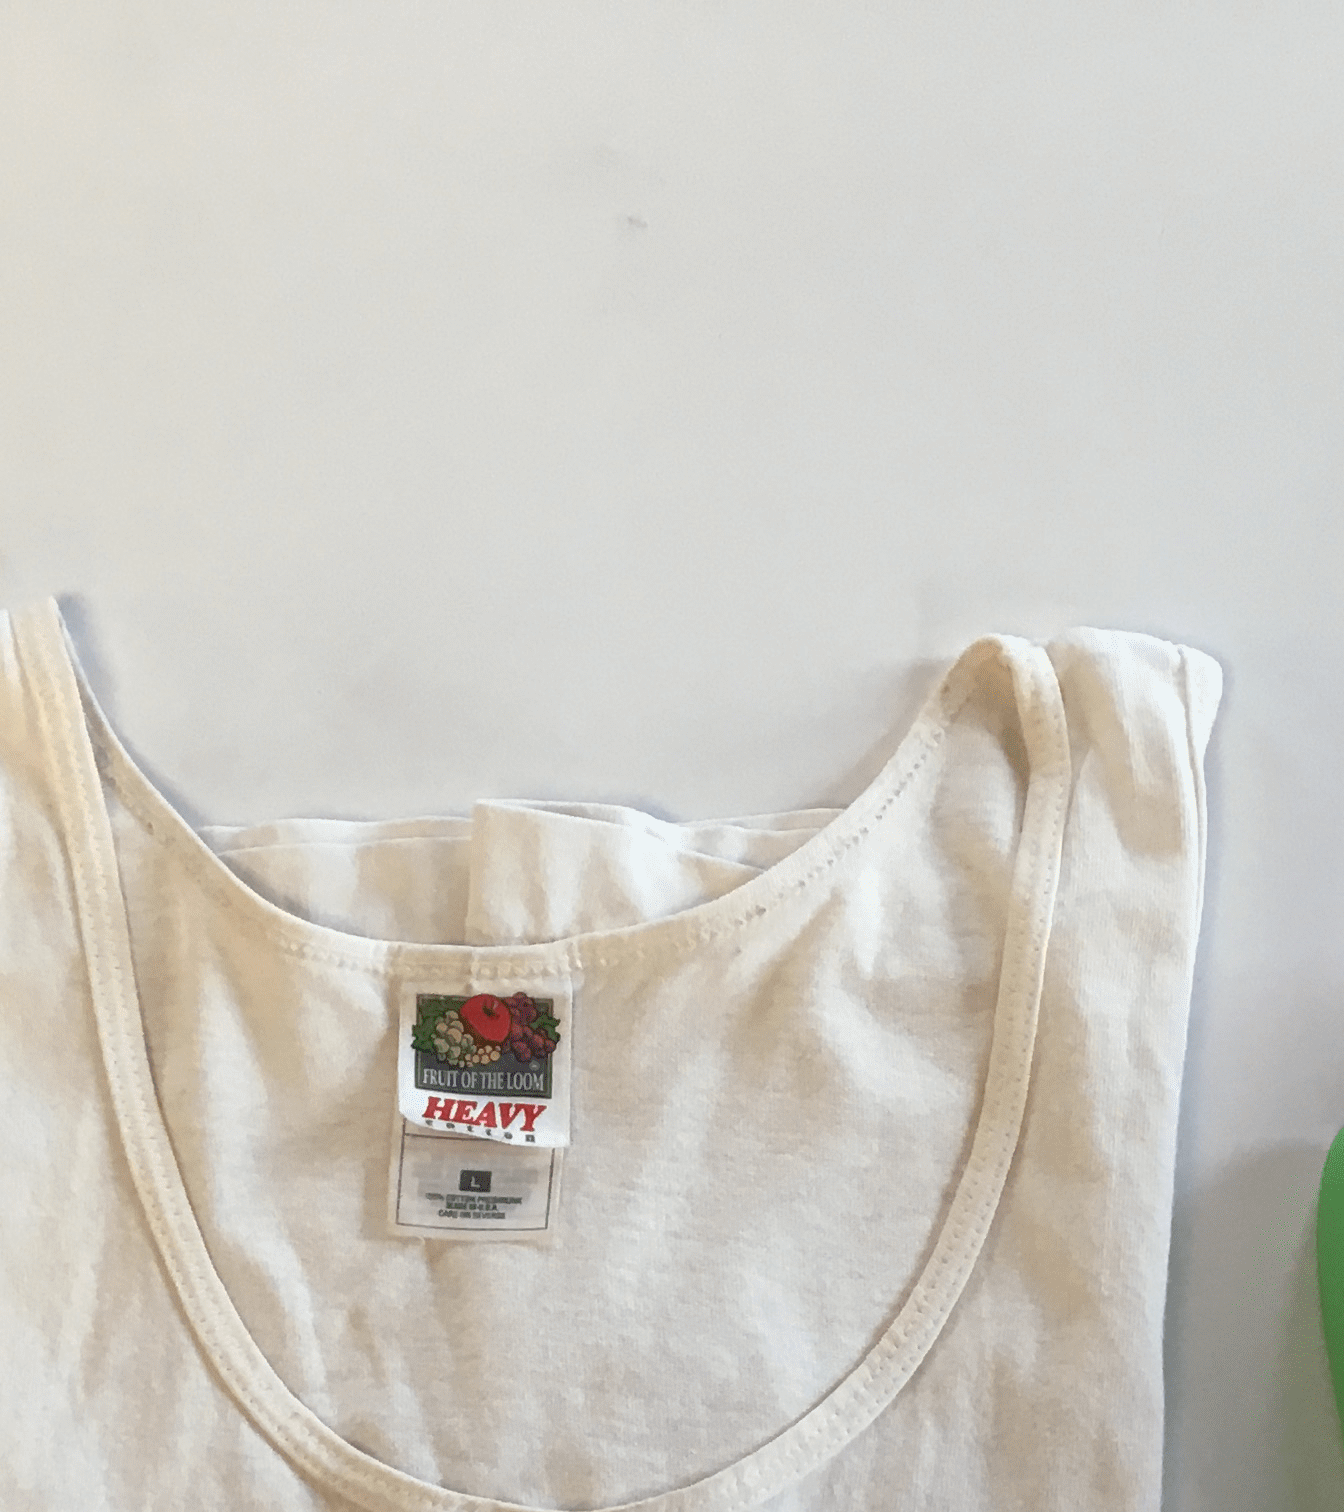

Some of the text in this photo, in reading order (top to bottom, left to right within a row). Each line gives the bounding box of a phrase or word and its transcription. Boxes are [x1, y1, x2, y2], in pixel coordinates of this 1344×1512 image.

[422, 1068, 544, 1091] FRUIT OF THE LOOM
[422, 1096, 547, 1132] HEAVY
[470, 1175, 481, 1189] L
